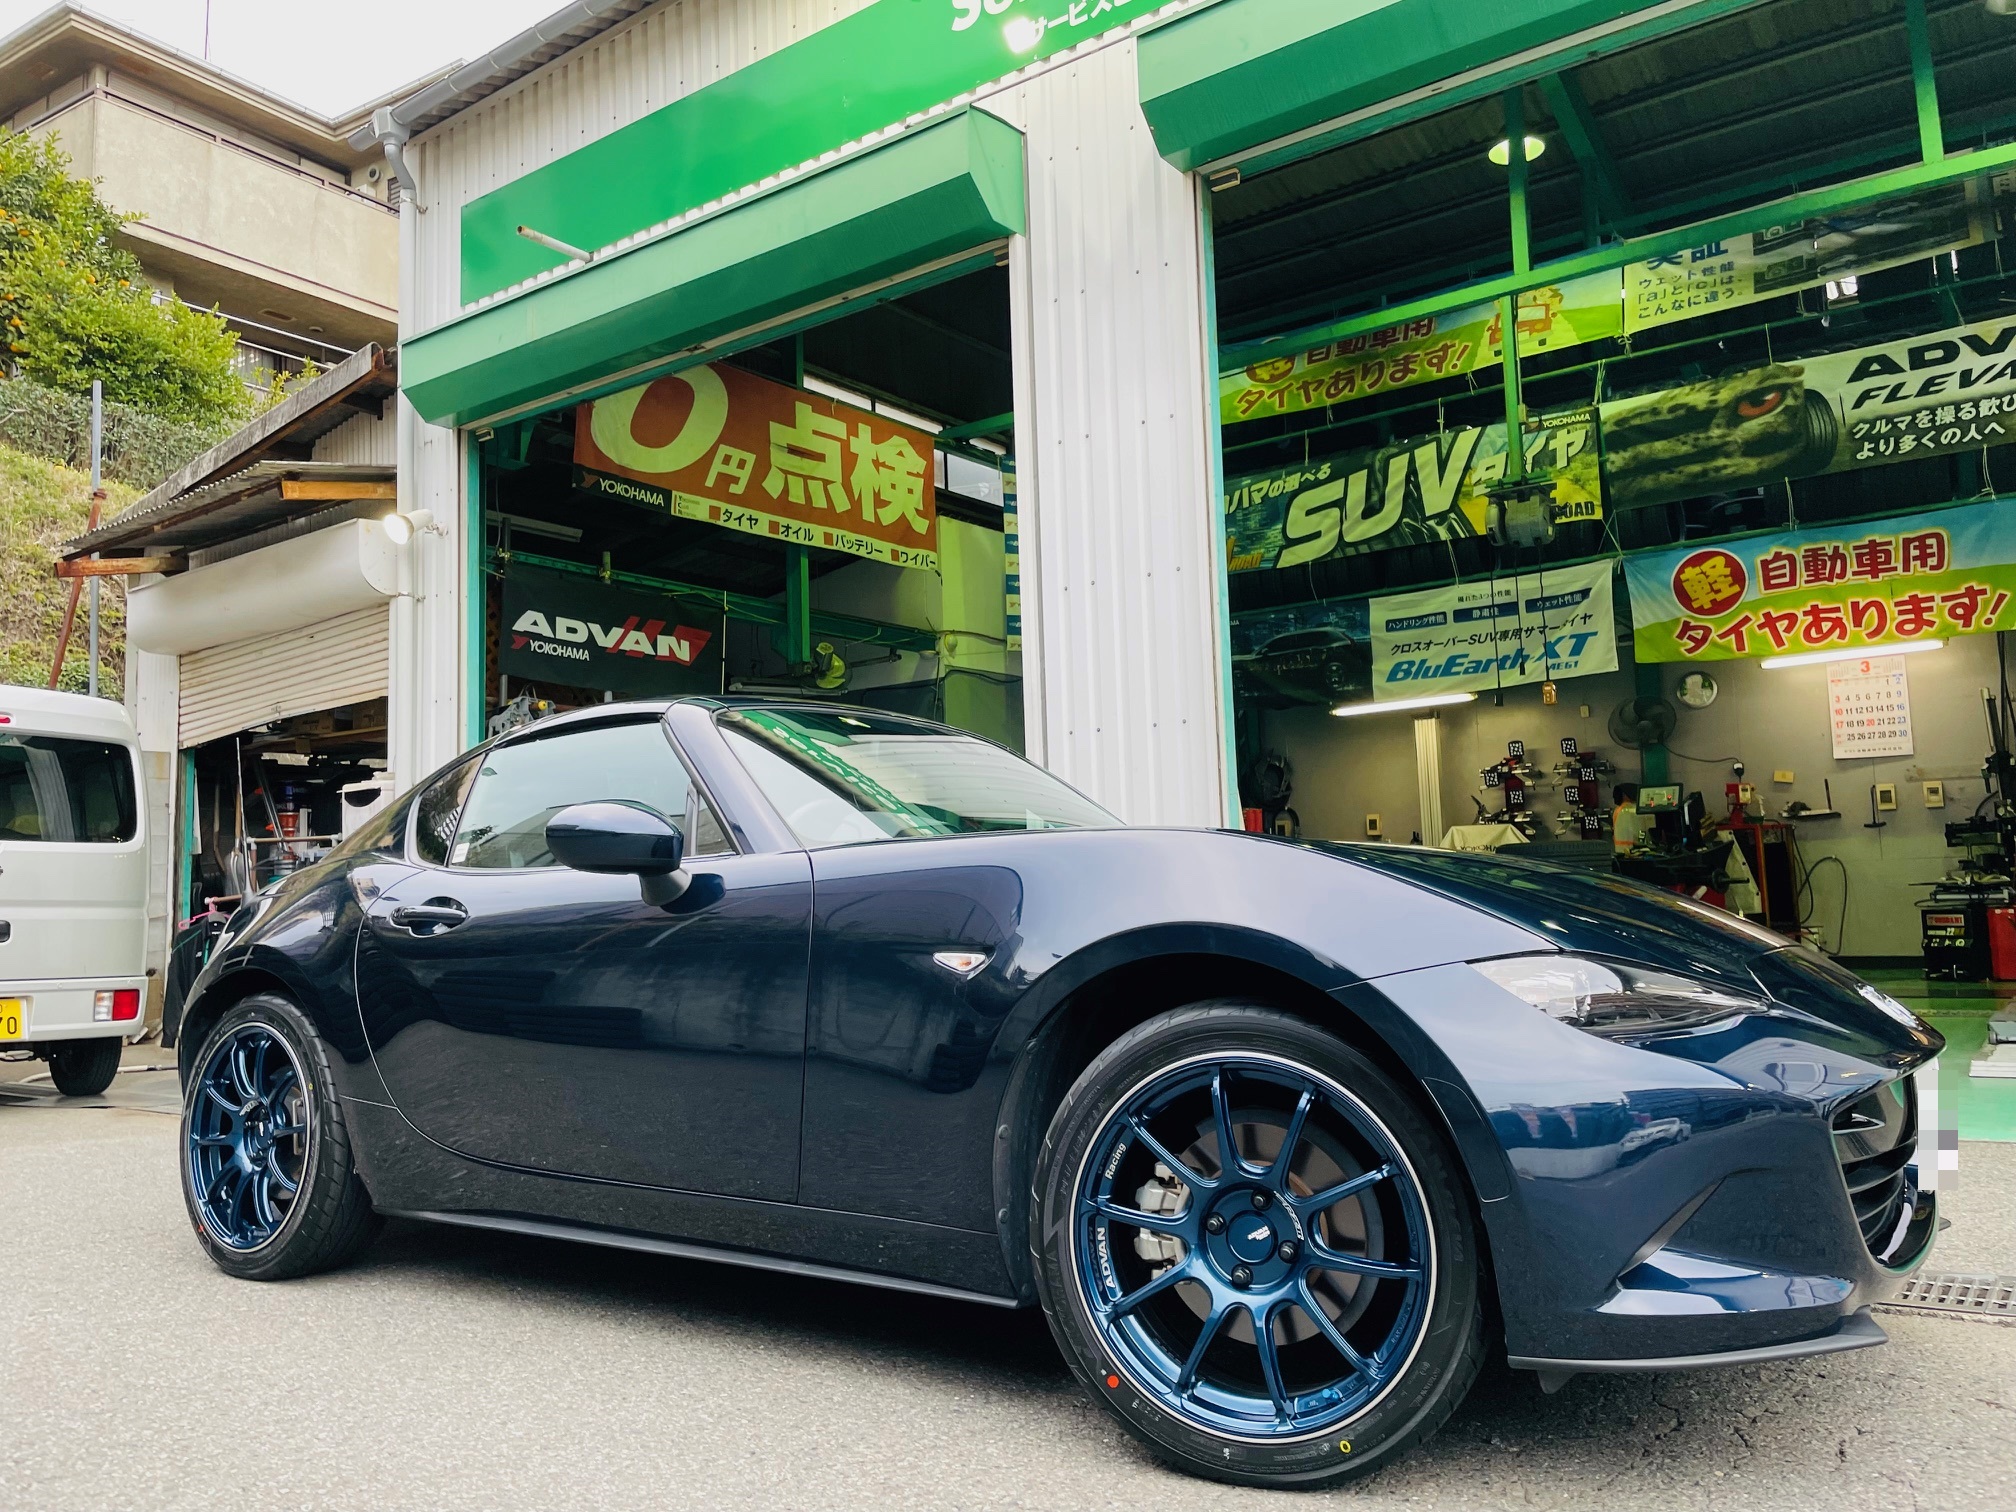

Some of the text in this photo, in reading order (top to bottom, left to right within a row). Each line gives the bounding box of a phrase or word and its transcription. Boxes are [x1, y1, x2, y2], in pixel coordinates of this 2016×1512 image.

[1543, 413, 1591, 428] YOKOHAMA
[1856, 421, 2006, 460] より多くの人へ
[600, 477, 664, 507] YOKOHAMA
[722, 508, 937, 567] タイヤ オイル バッテリー ワイパー
[1680, 532, 1946, 610] 軽 自動車用
[512, 610, 690, 662] ADVAN
[1675, 585, 2010, 655] タイヤあります!
[530, 639, 590, 661] YOKOHAMA
[1860, 660, 1870, 673] 3
[1876, 705, 1884, 713] 14
[1886, 704, 1895, 712] 15
[1847, 733, 1855, 741] 25
[1857, 732, 1866, 740] 26
[1867, 732, 1876, 740] 27
[1877, 731, 1886, 739] 28
[1888, 730, 1897, 738] 29
[0, 1016, 17, 1035] 0
[1104, 1142, 1127, 1180] Racing
[1097, 1227, 1117, 1289] ADVAN
